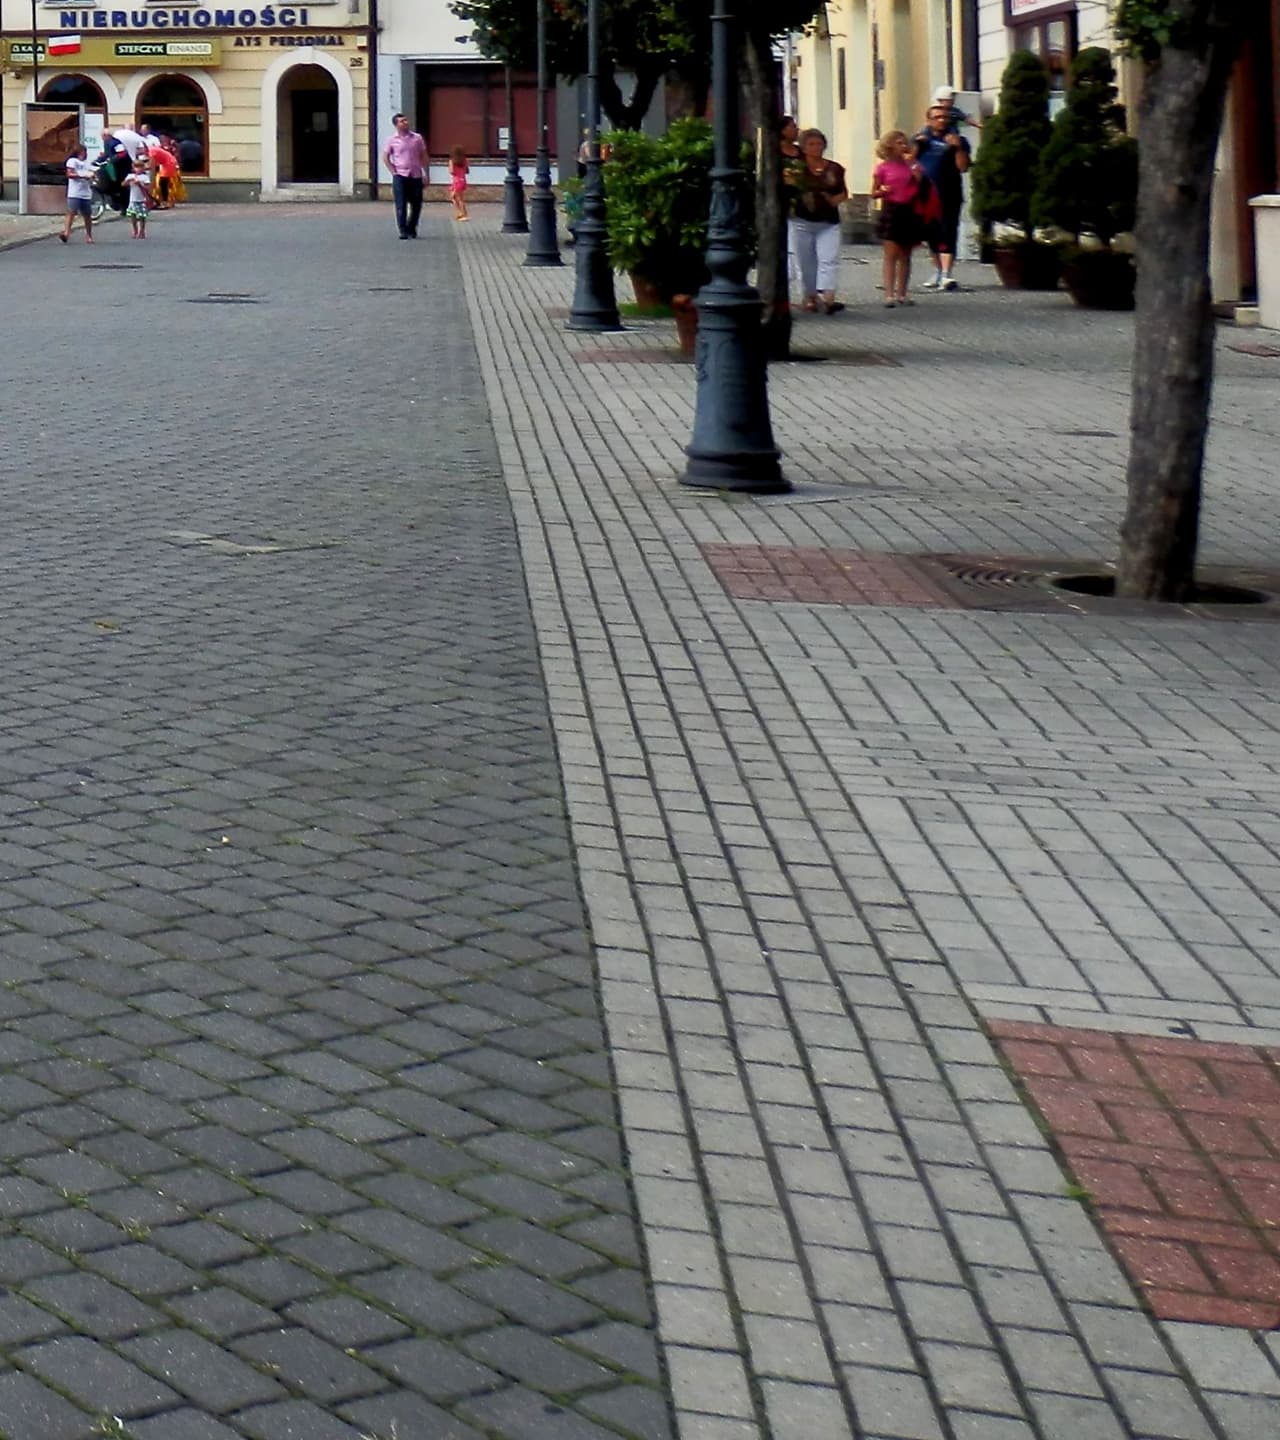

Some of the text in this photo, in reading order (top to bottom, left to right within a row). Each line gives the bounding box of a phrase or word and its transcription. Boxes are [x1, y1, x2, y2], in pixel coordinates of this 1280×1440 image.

[60, 5, 309, 28] NIERUCHOMOŚCI
[234, 35, 345, 47] ATS PERSONAL
[118, 44, 210, 54] STEFCZYK FINANSE
